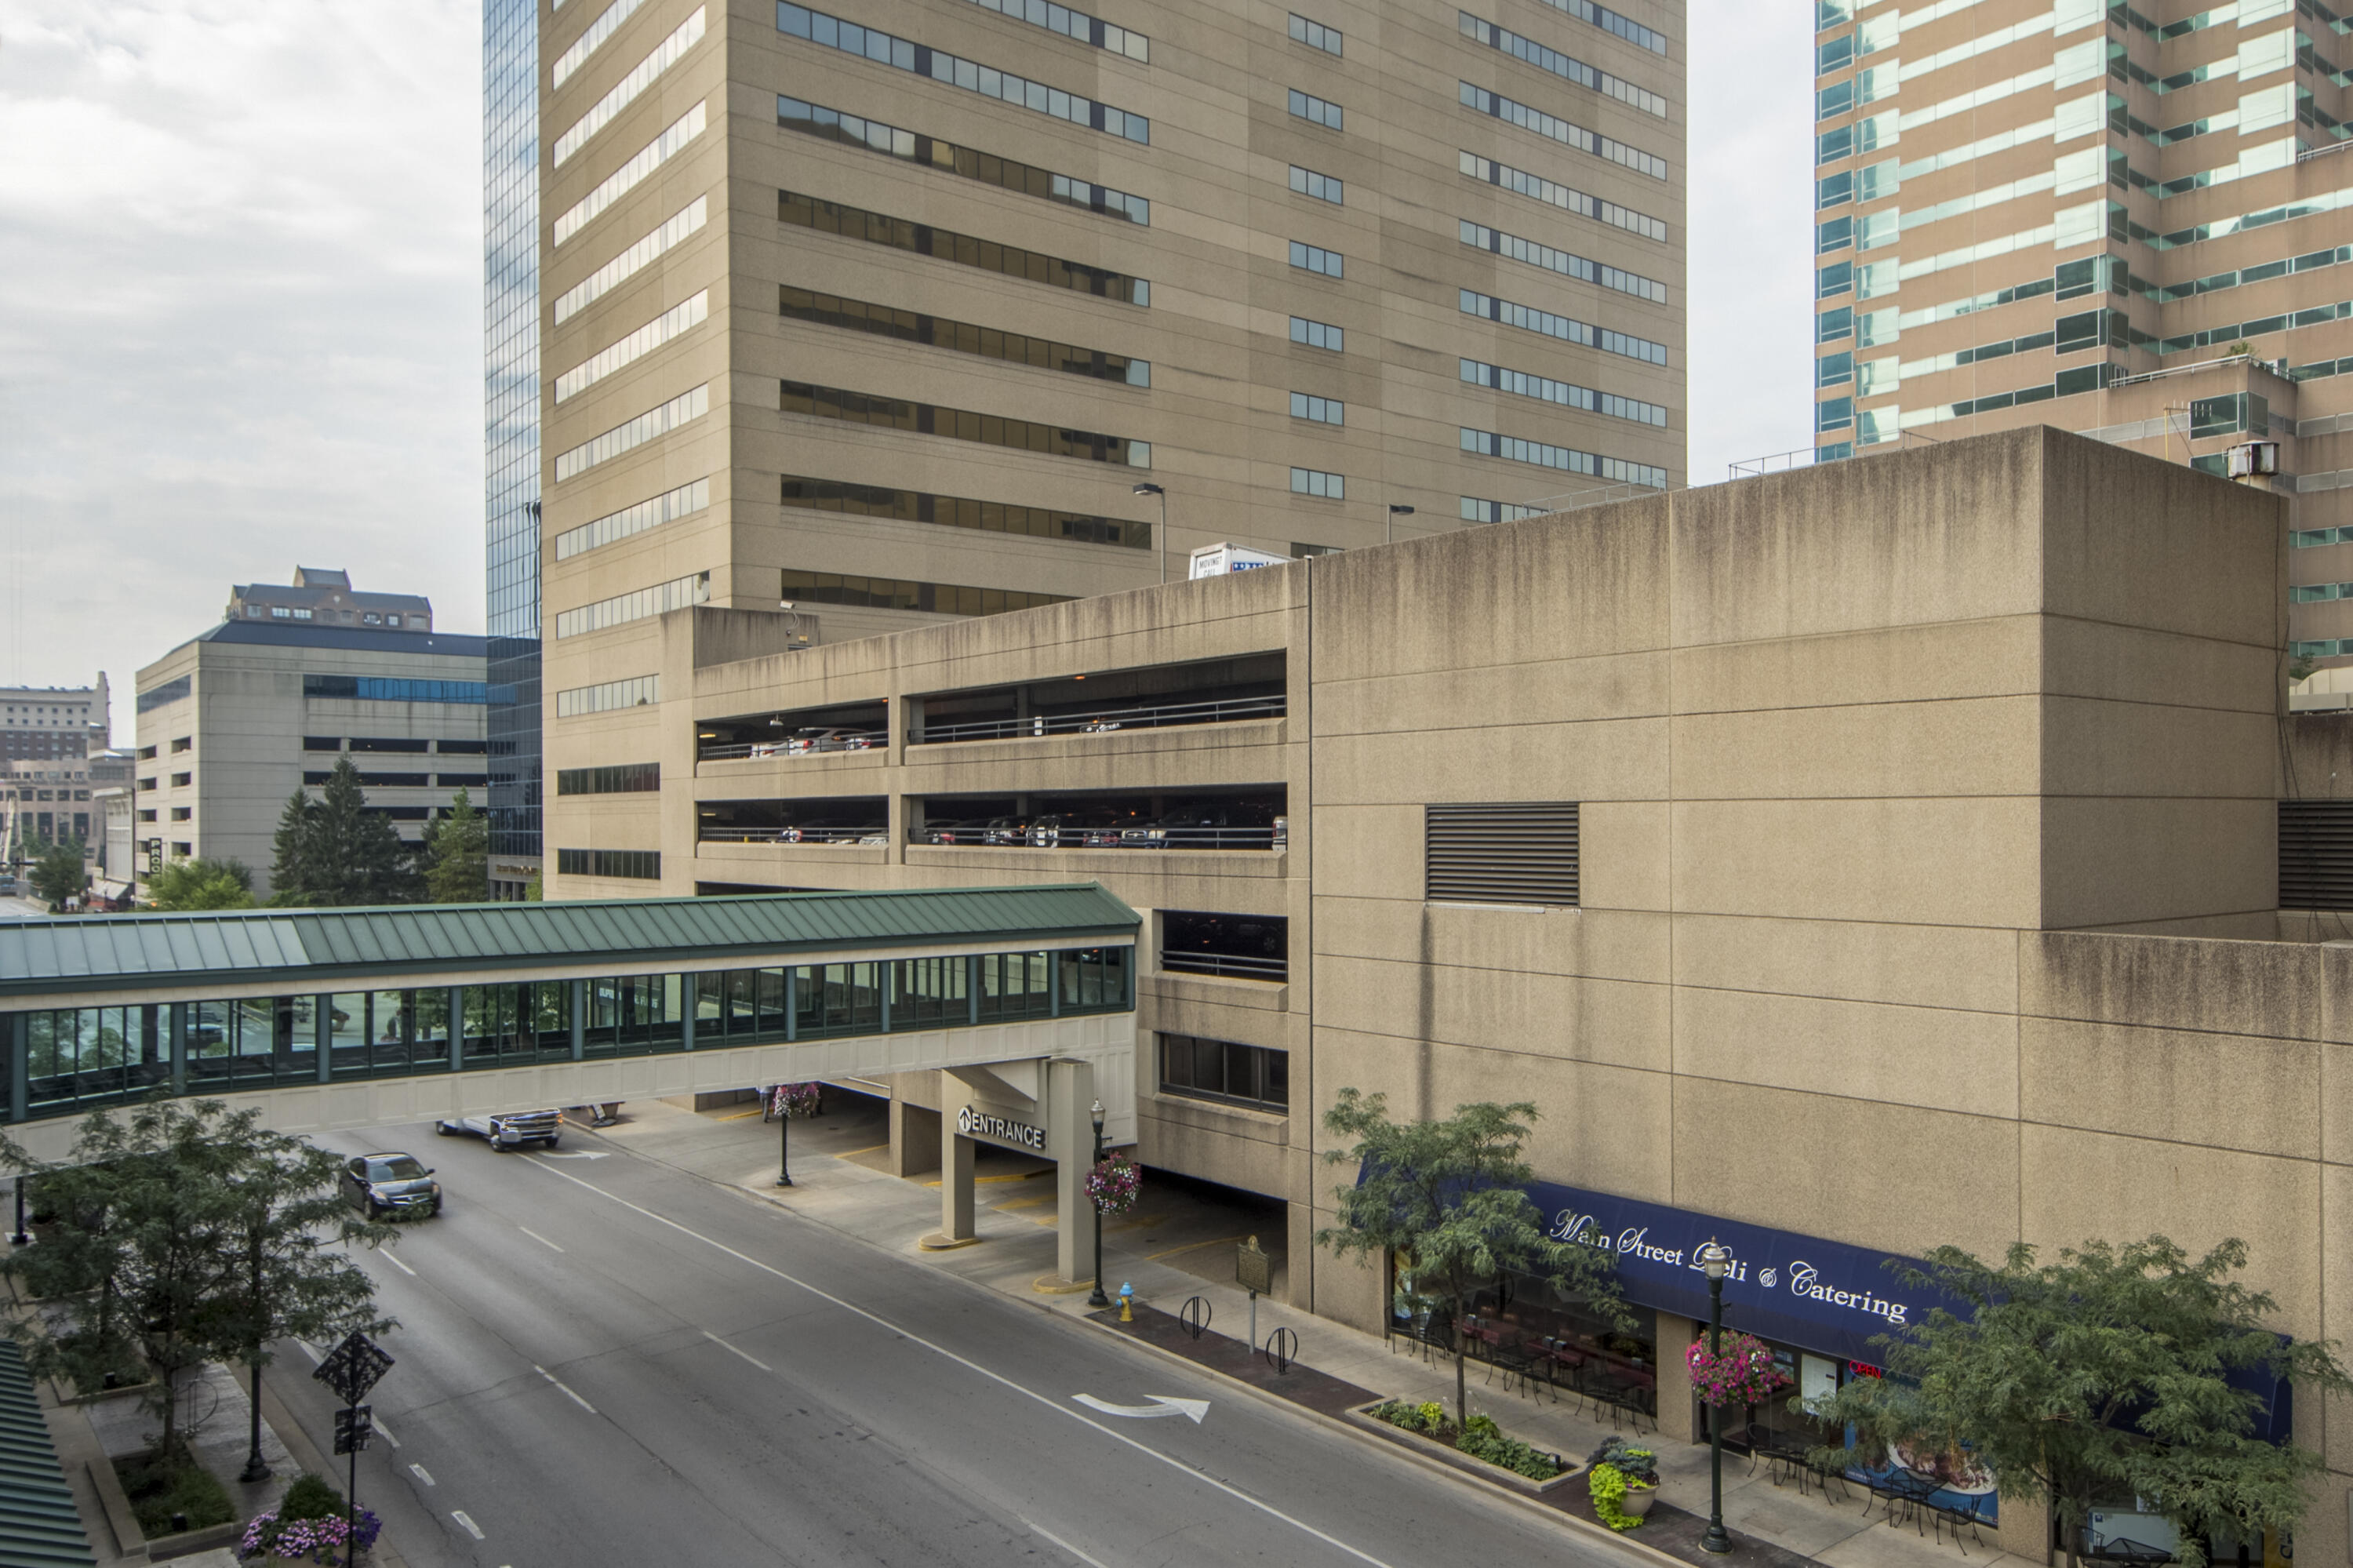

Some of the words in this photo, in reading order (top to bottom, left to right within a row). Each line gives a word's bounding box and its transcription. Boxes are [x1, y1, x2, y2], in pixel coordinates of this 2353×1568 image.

[1199, 555, 1223, 569] MOVING?
[151, 839, 161, 879] PROO
[972, 1112, 1042, 1148] ENTRANCE
[1617, 1227, 1683, 1266] Street
[1759, 1268, 1777, 1287] &
[1790, 1261, 1908, 1324] Catering
[1849, 1359, 1881, 1380] OPEN
